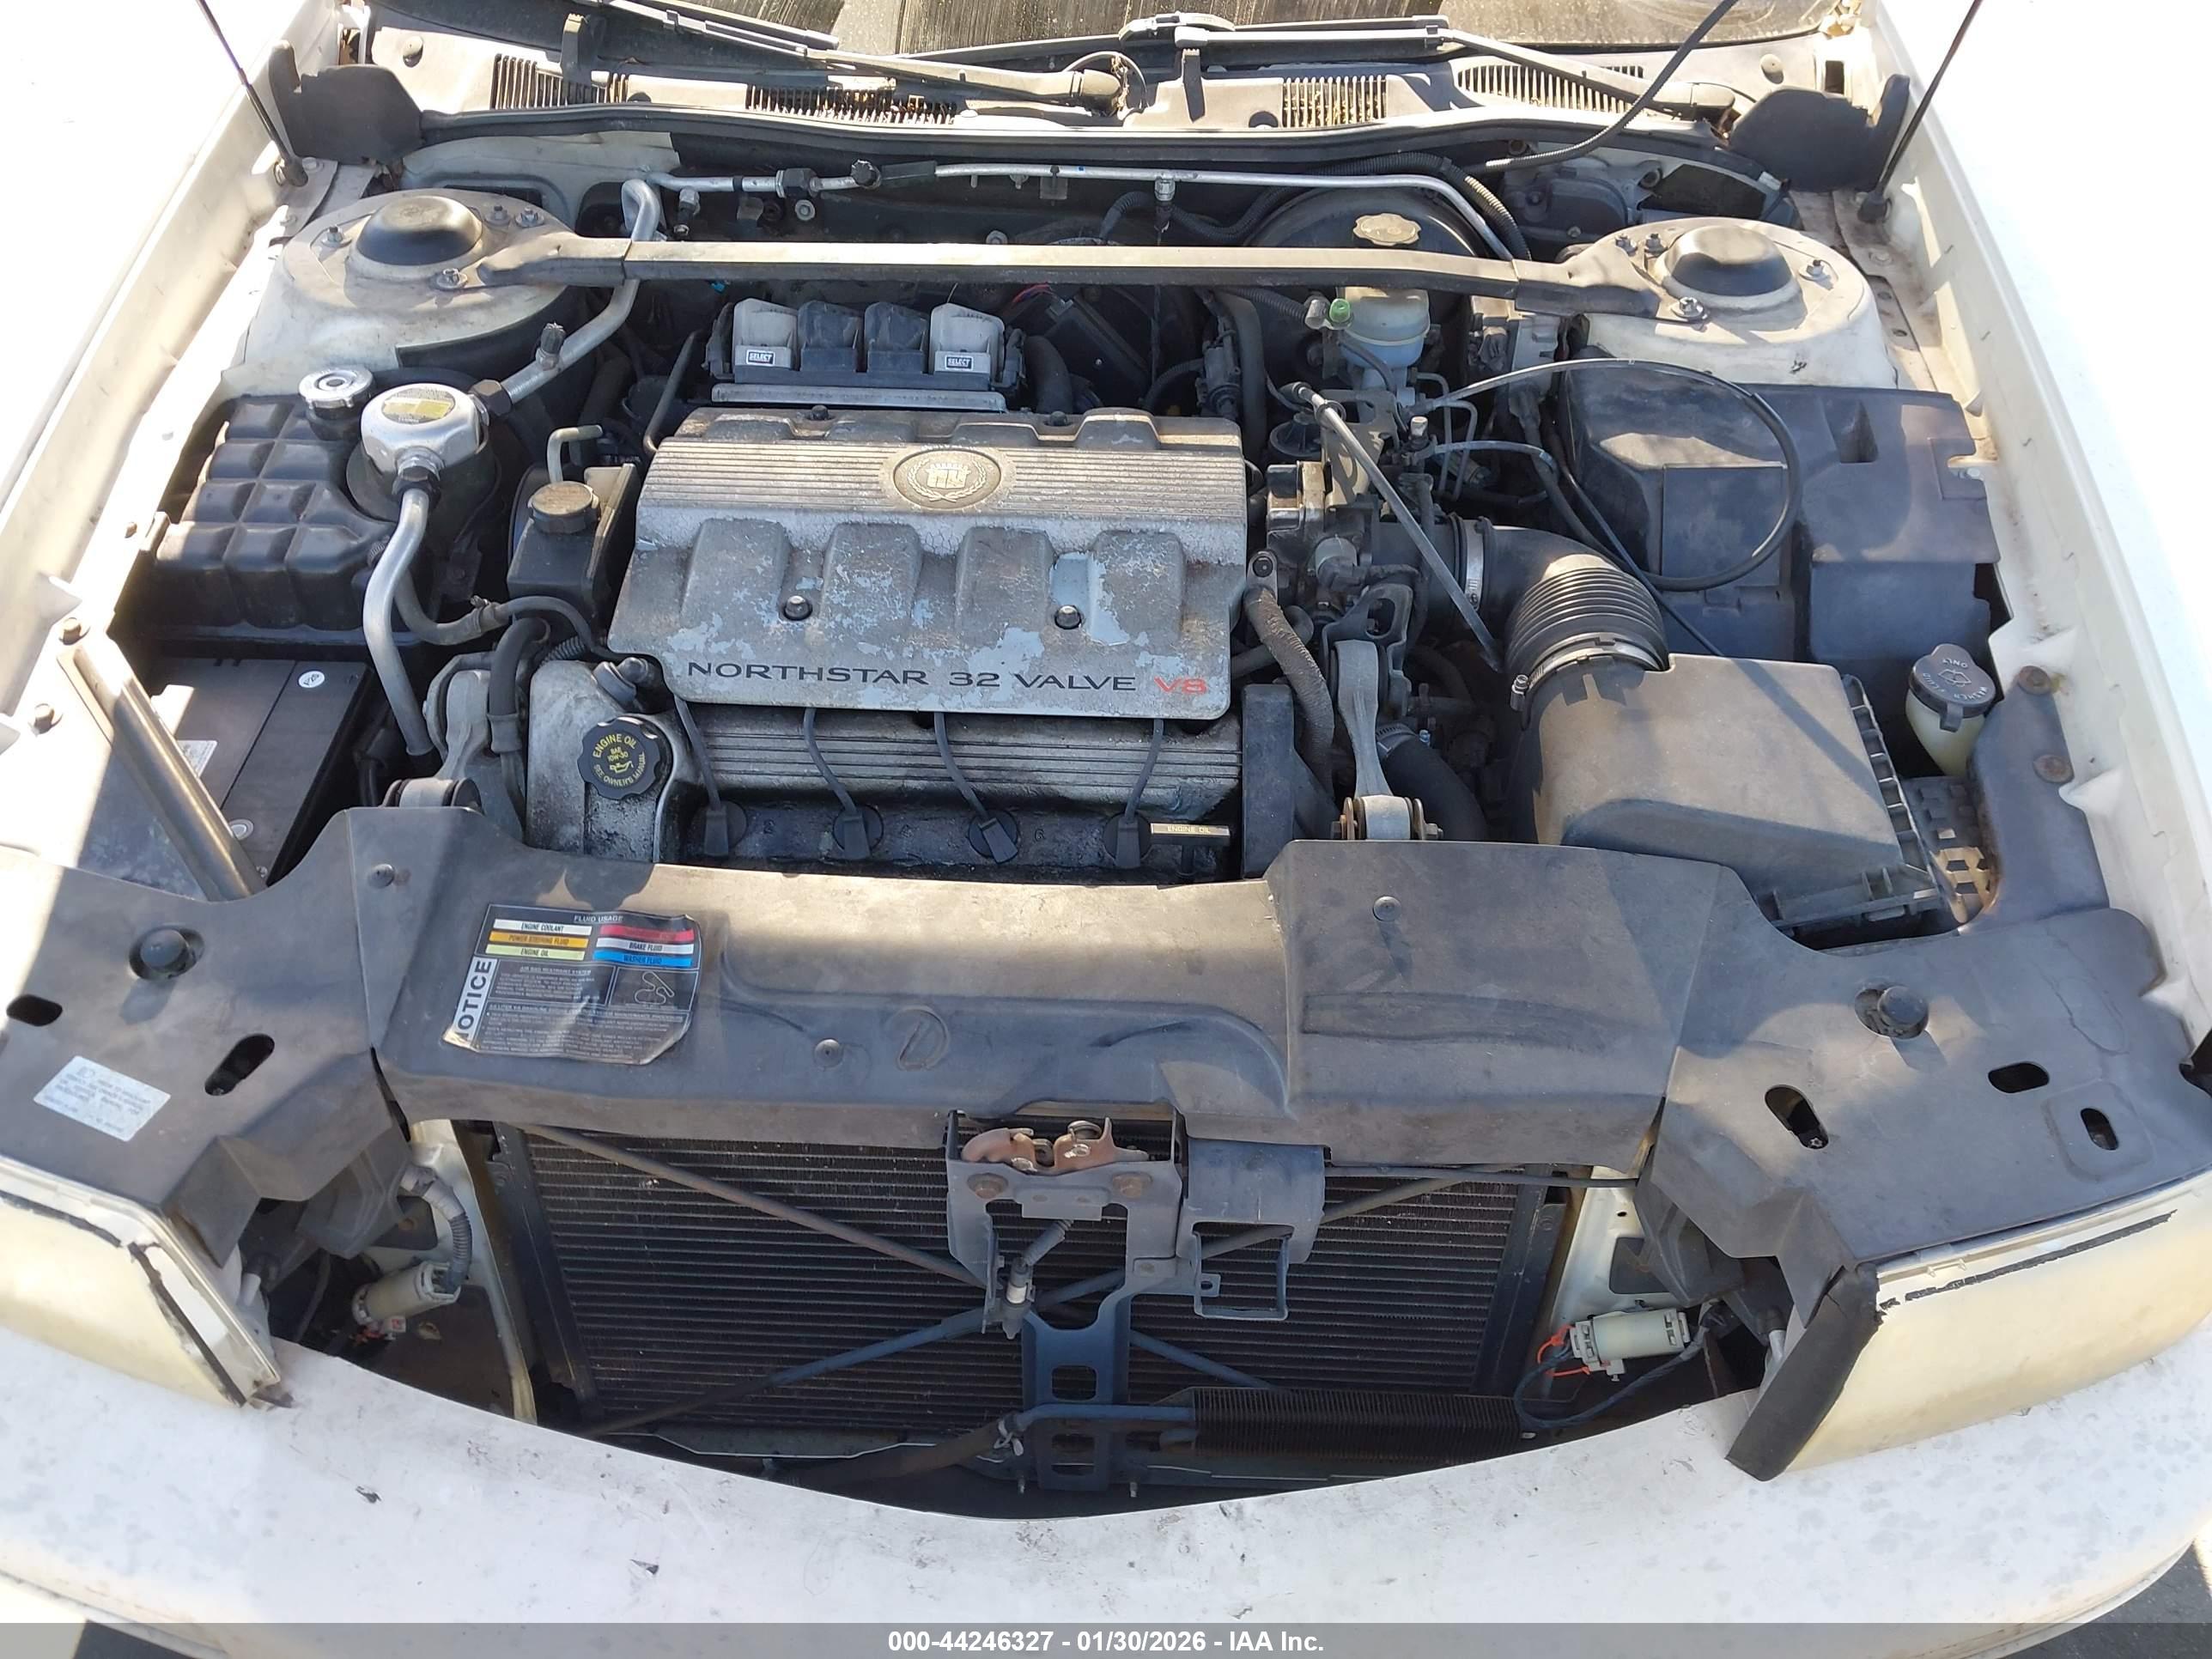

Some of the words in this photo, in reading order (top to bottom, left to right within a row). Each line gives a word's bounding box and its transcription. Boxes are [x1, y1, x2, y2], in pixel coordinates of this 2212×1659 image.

[749, 352, 773, 362] SELECT
[947, 357, 971, 368] SELECT
[688, 661, 930, 685] NORTHSTAR
[948, 672, 1001, 688] 32
[1014, 673, 1137, 692] VALVE
[1154, 676, 1208, 695] V8
[592, 733, 623, 758] ENGINE
[623, 735, 637, 750] OIL
[629, 942, 647, 951] BRAKE
[647, 943, 663, 951] FLUID
